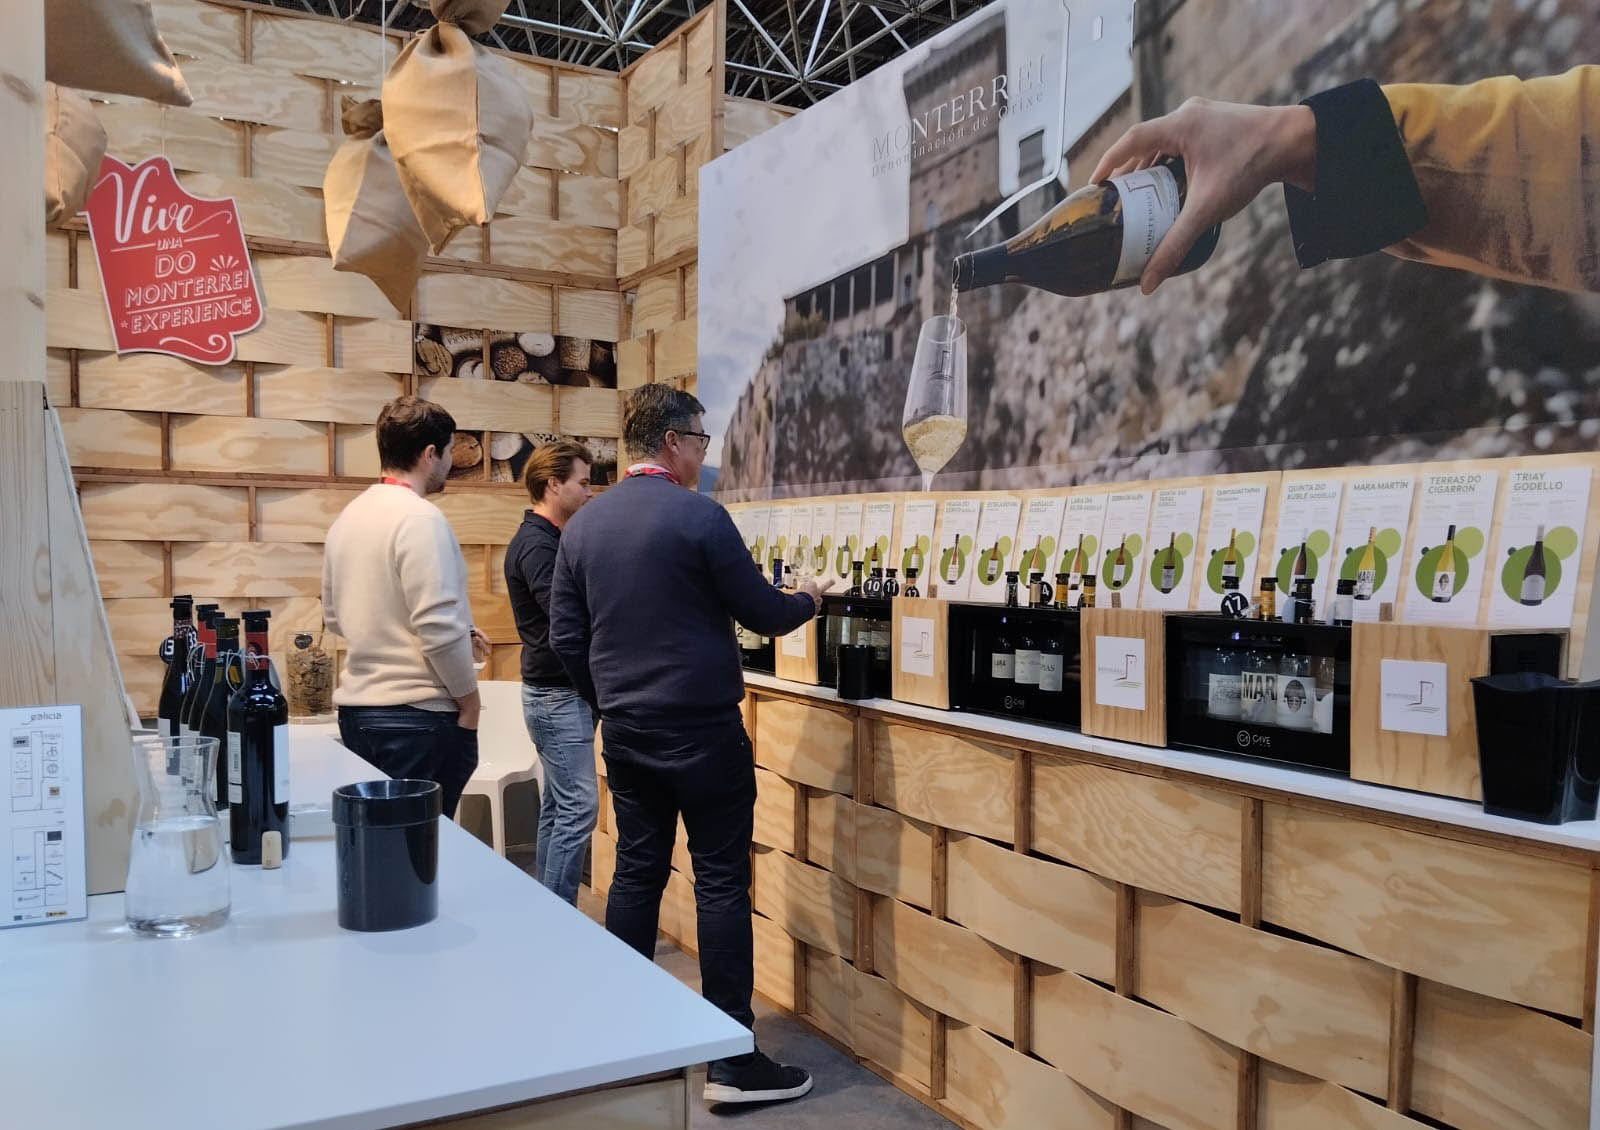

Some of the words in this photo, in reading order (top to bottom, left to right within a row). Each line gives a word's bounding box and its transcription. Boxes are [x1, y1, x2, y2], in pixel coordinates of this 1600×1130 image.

[973, 115, 989, 131] de
[94, 166, 231, 243] Vive
[157, 237, 183, 251] UNA
[155, 250, 196, 278] DO
[125, 270, 250, 308] MONTERREI
[131, 297, 253, 334] EXPERIENCE
[1430, 475, 1466, 485] TERRAS
[1467, 475, 1482, 484] DO
[1514, 472, 1547, 482] TRIAY
[1353, 481, 1376, 490] MARA
[1513, 482, 1564, 491] GODELLO
[867, 576, 880, 592] 10
[886, 576, 896, 593] 11
[187, 631, 197, 649] 33
[736, 626, 744, 638] 2
